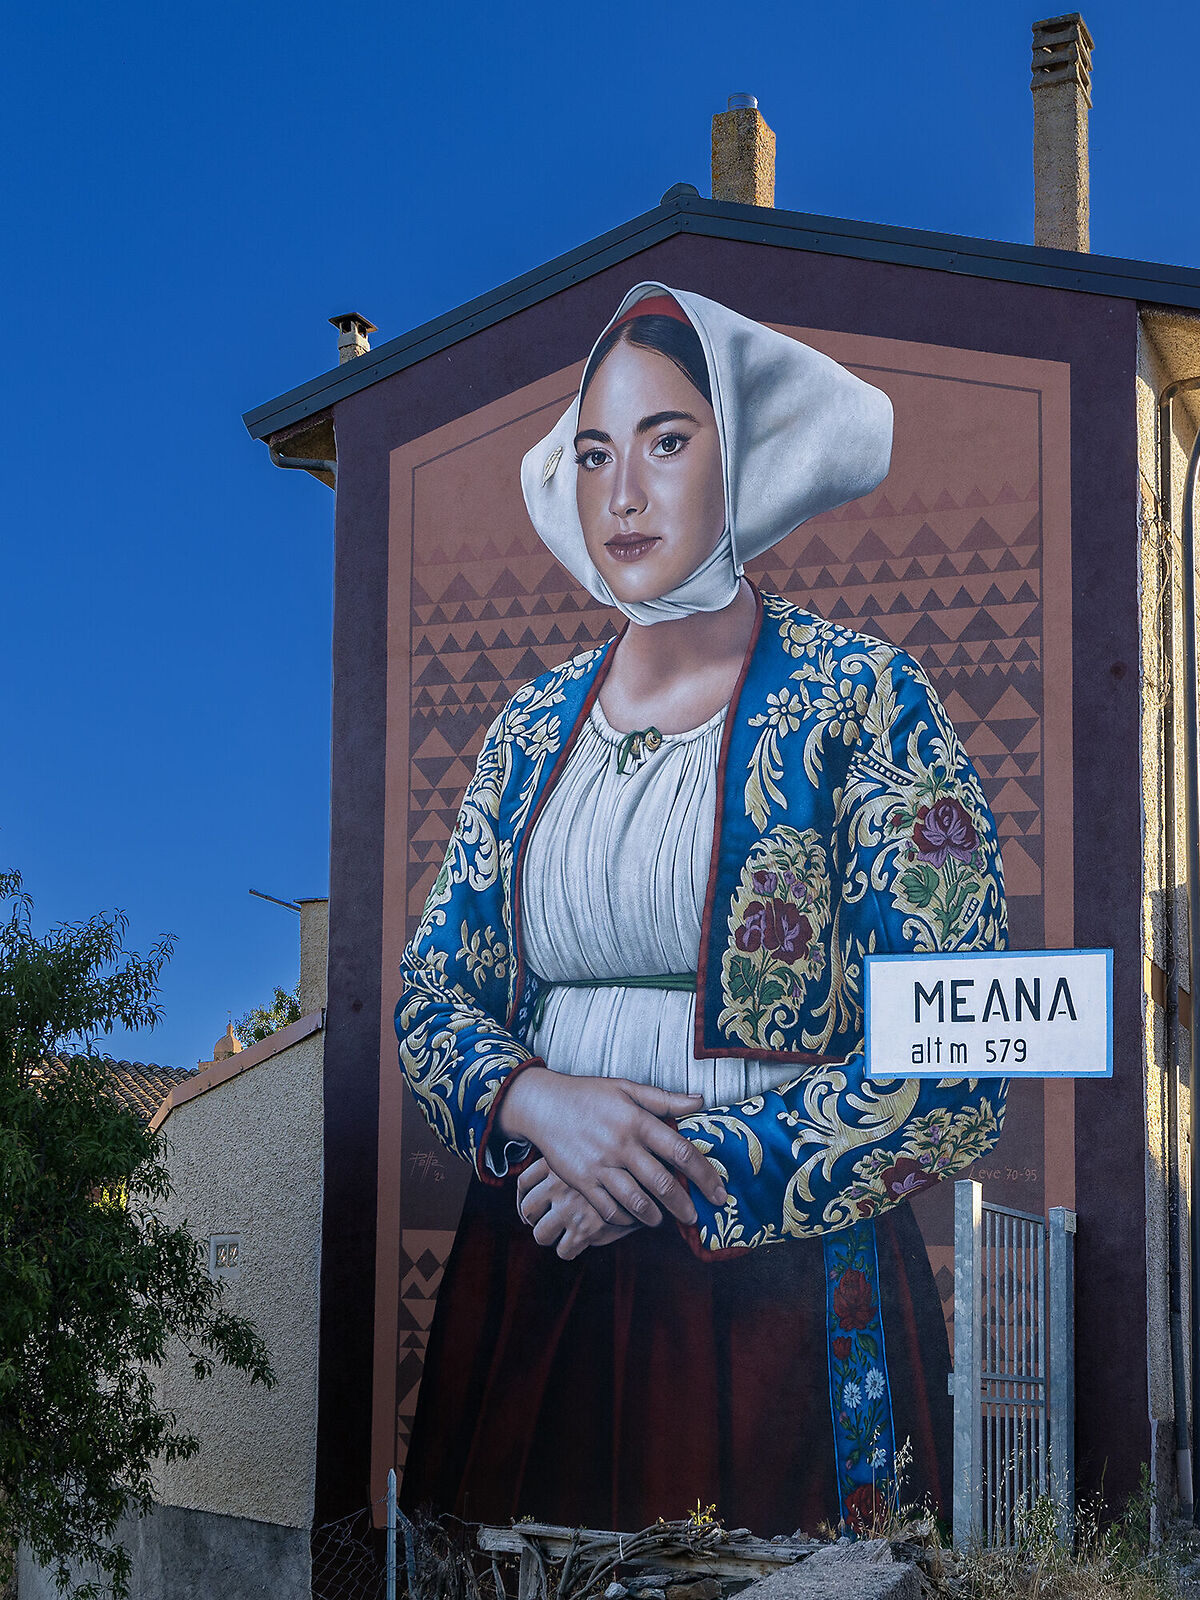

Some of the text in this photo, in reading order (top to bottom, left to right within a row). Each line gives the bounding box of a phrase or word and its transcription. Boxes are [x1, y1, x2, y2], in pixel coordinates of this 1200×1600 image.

[914, 977, 1077, 1023] MEANA
[950, 1042, 968, 1064] m
[985, 1038, 1027, 1063] 579
